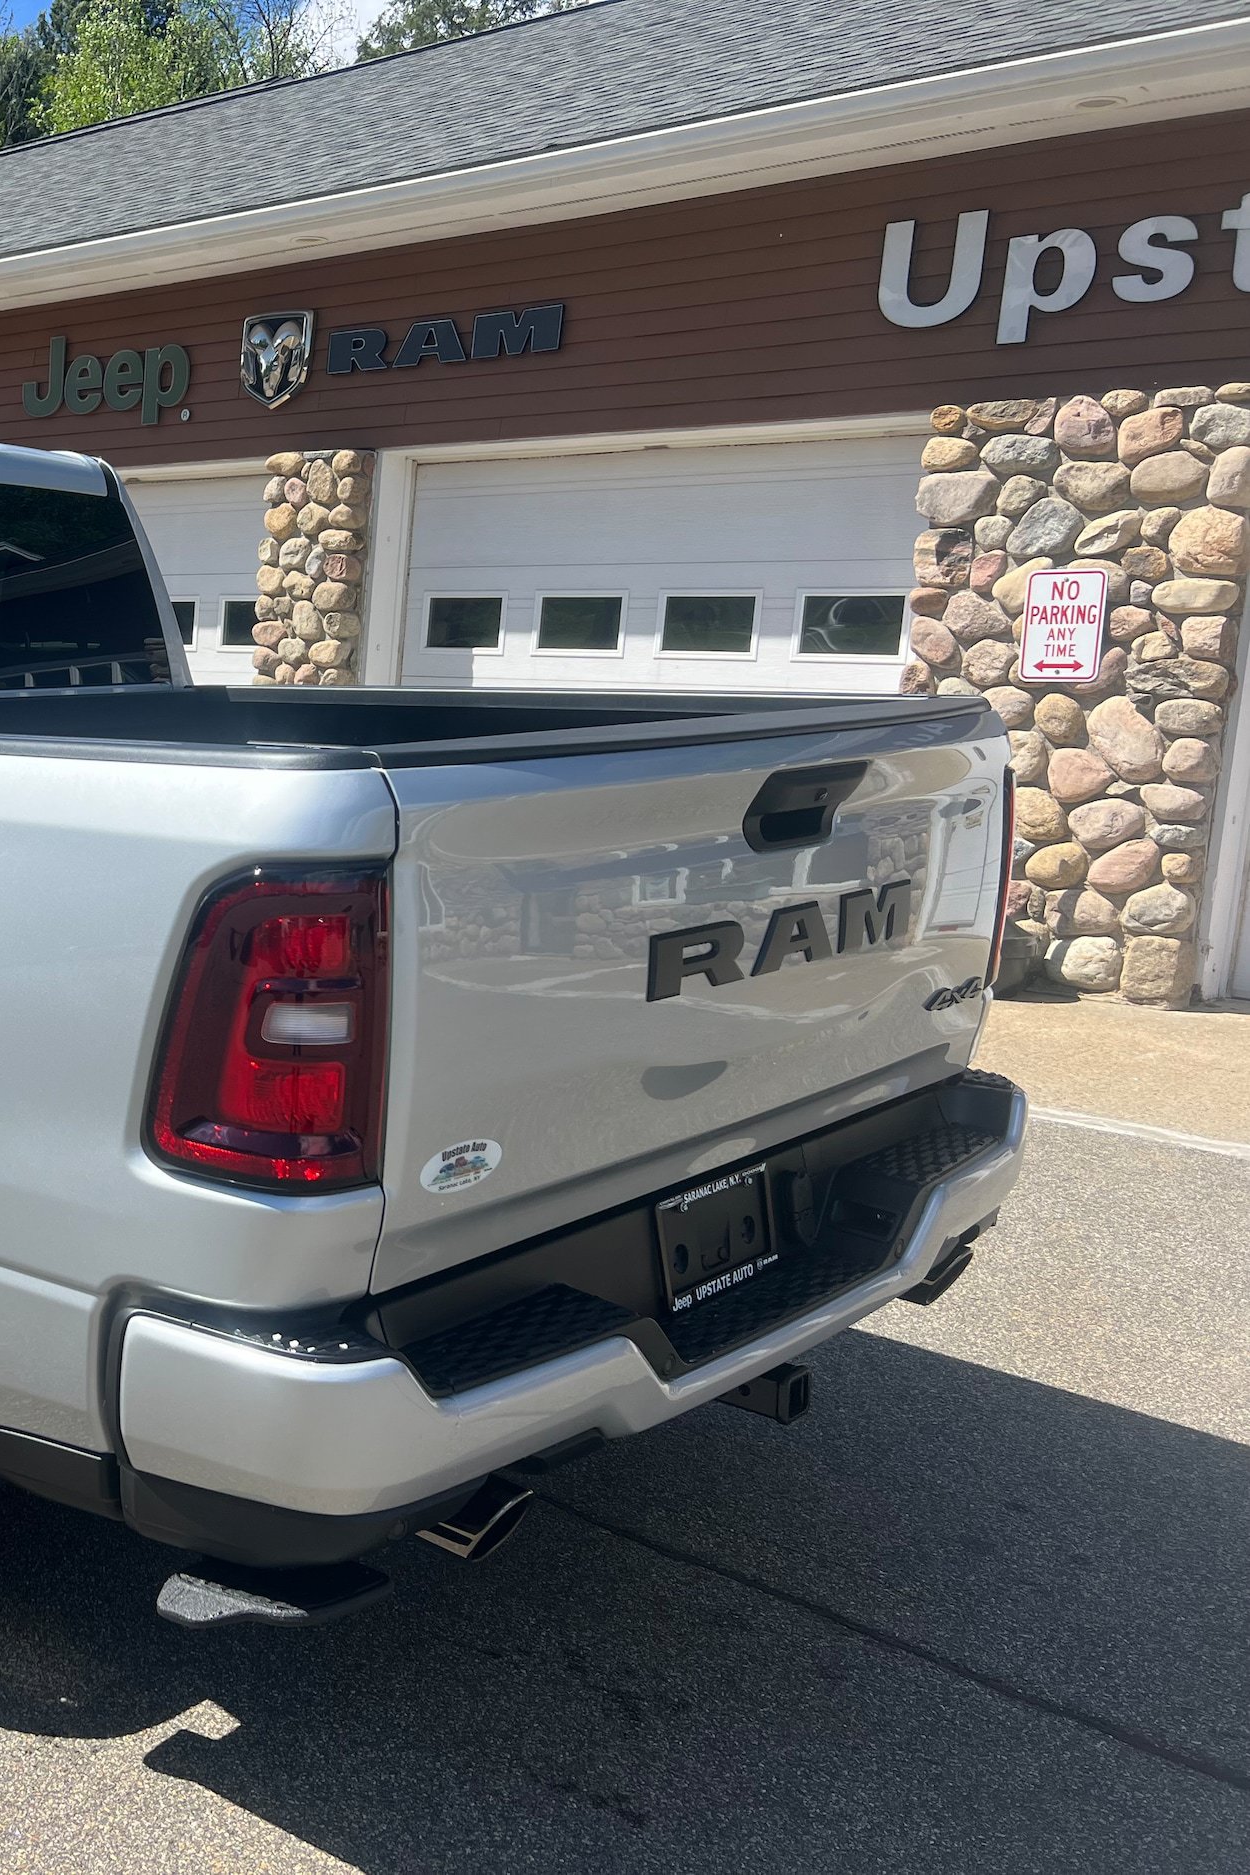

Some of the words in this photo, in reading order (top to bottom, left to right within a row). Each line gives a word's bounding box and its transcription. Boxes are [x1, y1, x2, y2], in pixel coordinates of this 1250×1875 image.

[326, 304, 564, 375] RAM
[22, 336, 191, 425] Jeep
[1051, 580, 1080, 601] NO
[1030, 604, 1098, 625] PARKING
[1046, 627, 1077, 641] ANY
[1044, 643, 1077, 658] TIME
[646, 879, 911, 1002] RAM
[441, 1144, 471, 1162] Upstate
[470, 1141, 488, 1153] Auto
[683, 1184, 712, 1204] SARANAC
[712, 1178, 730, 1193] LAKE,
[729, 1174, 742, 1187] N.Y.
[763, 1253, 779, 1266] RAM
[672, 1293, 693, 1312] Jeep
[695, 1273, 731, 1301] UPSTATE
[732, 1263, 754, 1284] AUTO
